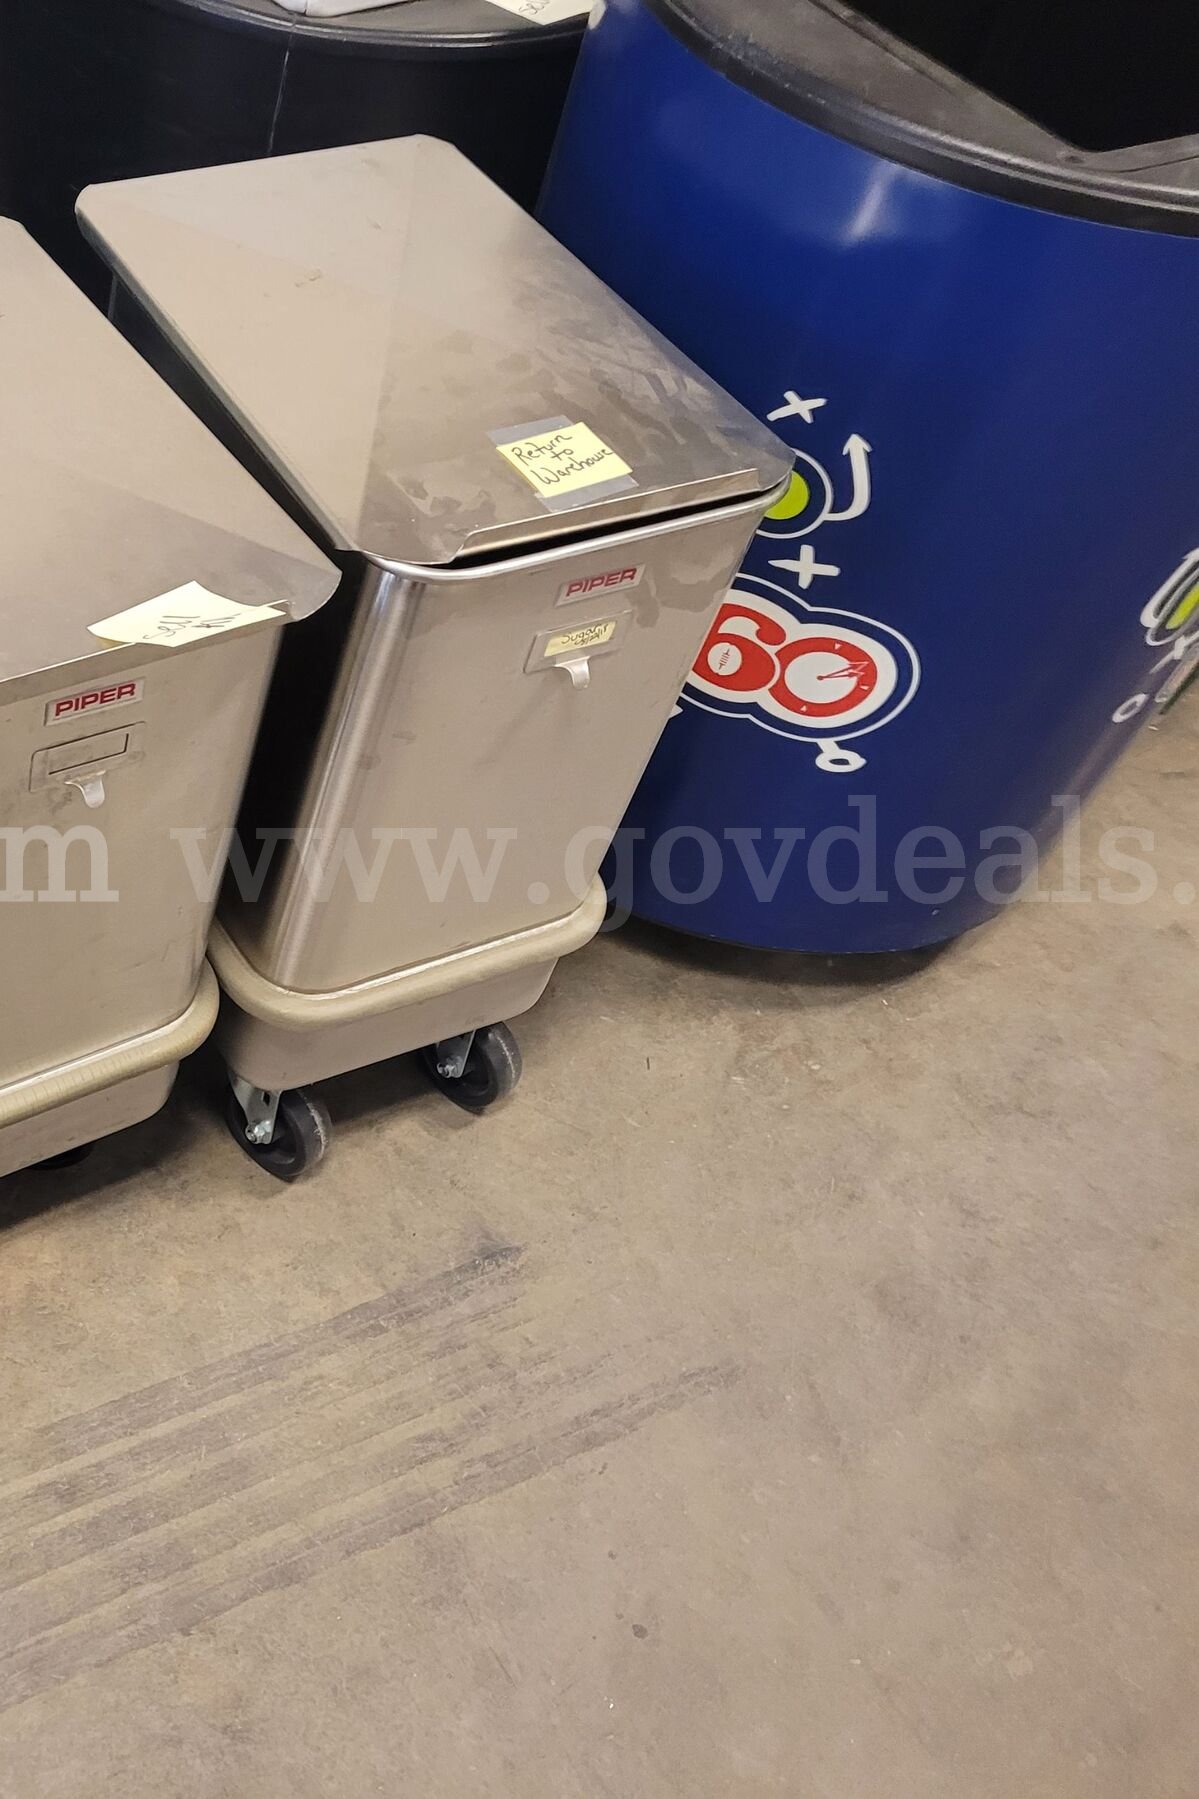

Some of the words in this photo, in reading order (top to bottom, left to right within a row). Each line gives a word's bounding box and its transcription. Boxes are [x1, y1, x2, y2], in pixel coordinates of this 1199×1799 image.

[511, 434, 573, 467] Return
[550, 447, 575, 462] to
[565, 567, 638, 598] PIPER
[54, 682, 136, 717] PIPER
